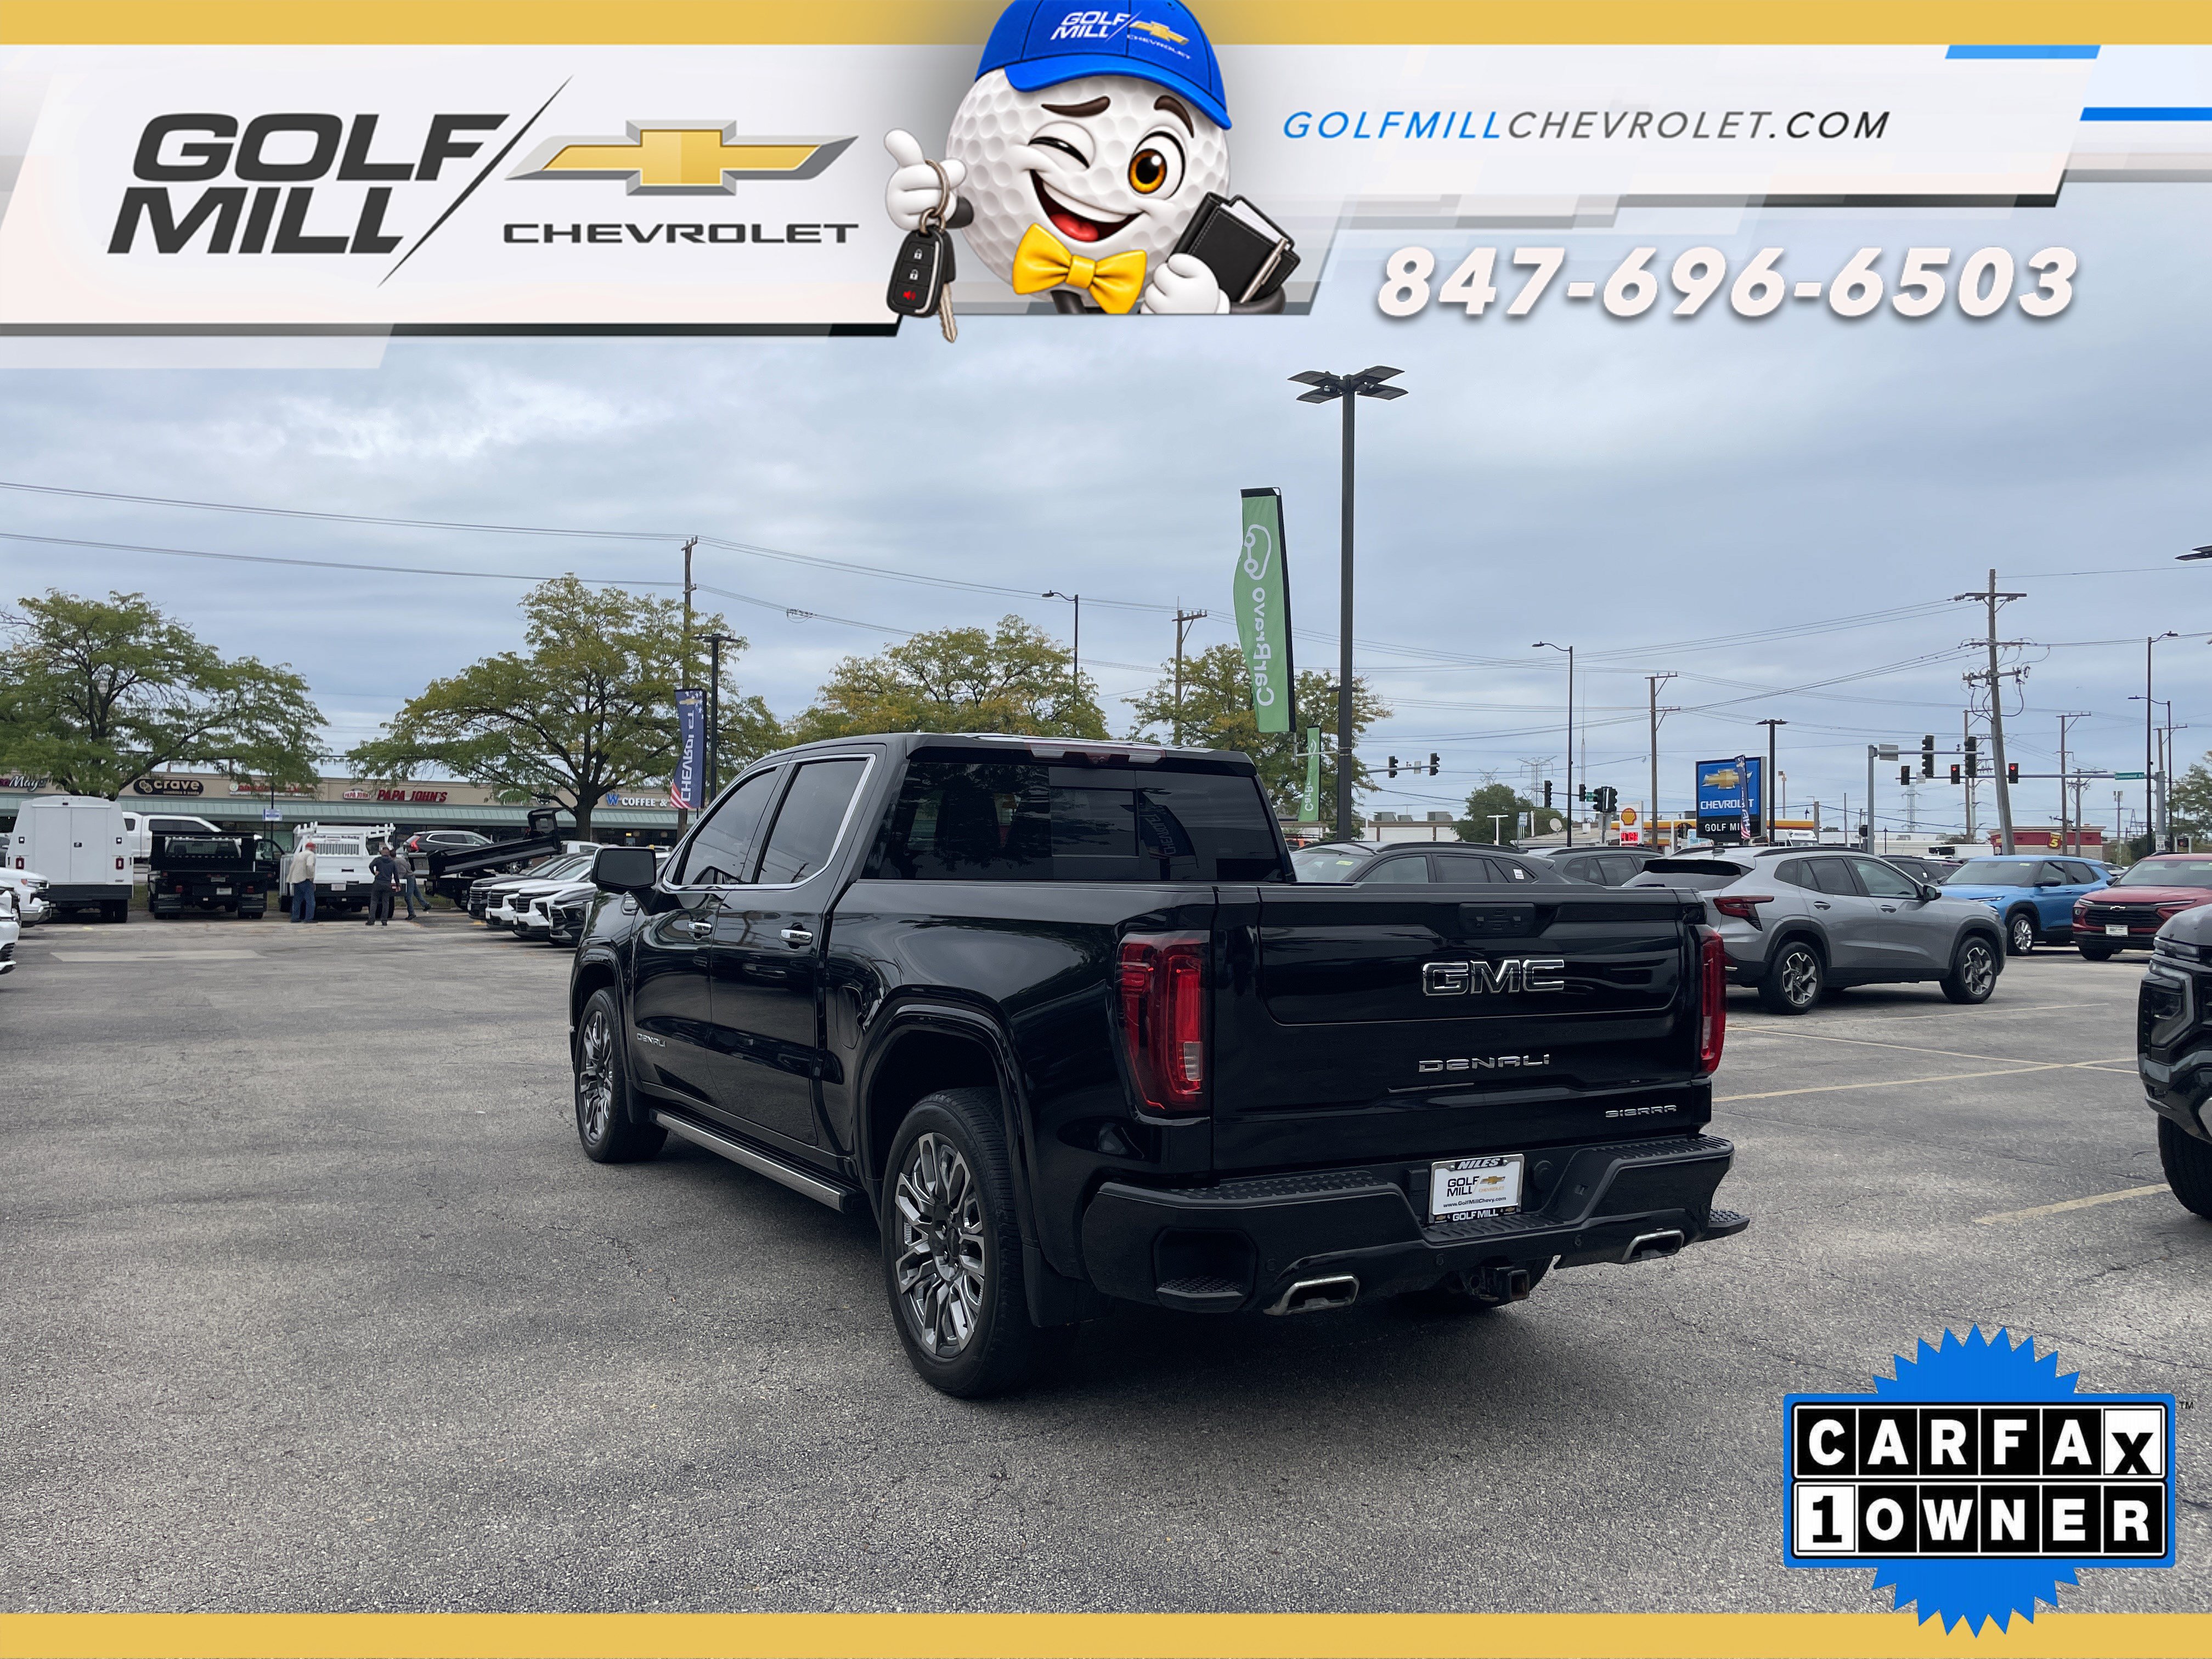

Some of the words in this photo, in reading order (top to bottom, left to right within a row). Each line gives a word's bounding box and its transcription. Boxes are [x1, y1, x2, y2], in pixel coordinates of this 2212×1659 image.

[154, 780, 200, 790] crave
[377, 789, 406, 802] PAPA
[409, 790, 448, 803] JOHN'S
[621, 797, 656, 807] COFFEE
[659, 799, 668, 807] &
[1700, 799, 1754, 810] CHEVROLT
[1705, 823, 1726, 832] GOLF
[1729, 822, 1740, 831] MI
[1422, 959, 1565, 996] GMC
[636, 1032, 667, 1048] DENALI
[1418, 1053, 1550, 1073] DENALI
[1605, 1104, 1677, 1118] SIERRA
[1457, 1158, 1501, 1170] NILES
[1447, 1176, 1480, 1188] GOLF
[1447, 1186, 1473, 1197] MILL
[1443, 1196, 1507, 1208] www.GolfMillChevy.com
[1452, 1211, 1477, 1222] GOLF
[1477, 1209, 1499, 1218] MILL
